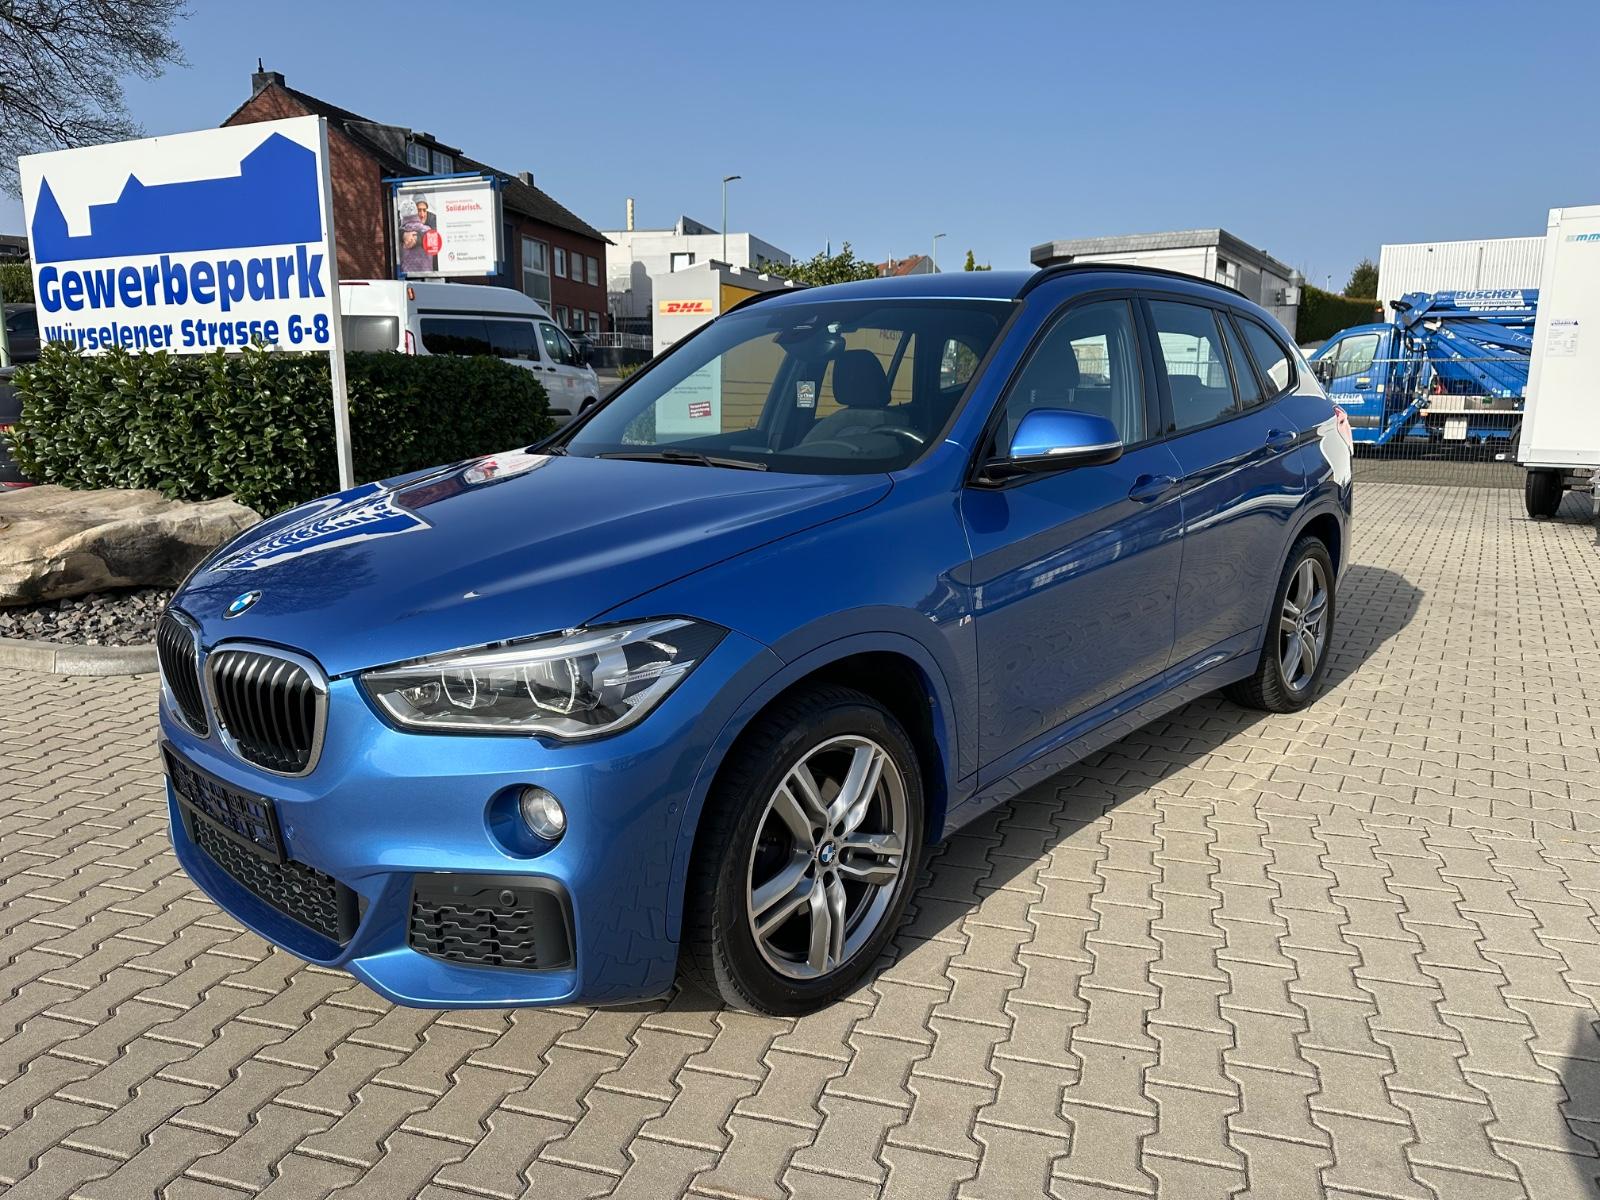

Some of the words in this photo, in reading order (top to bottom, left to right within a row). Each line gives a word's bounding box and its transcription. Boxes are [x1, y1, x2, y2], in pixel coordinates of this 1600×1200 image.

[38, 245, 325, 312] Gewerbepark
[667, 302, 705, 313] DHL
[44, 321, 173, 350] Würselener
[181, 319, 279, 346] Strasse
[288, 314, 329, 344] 6-8
